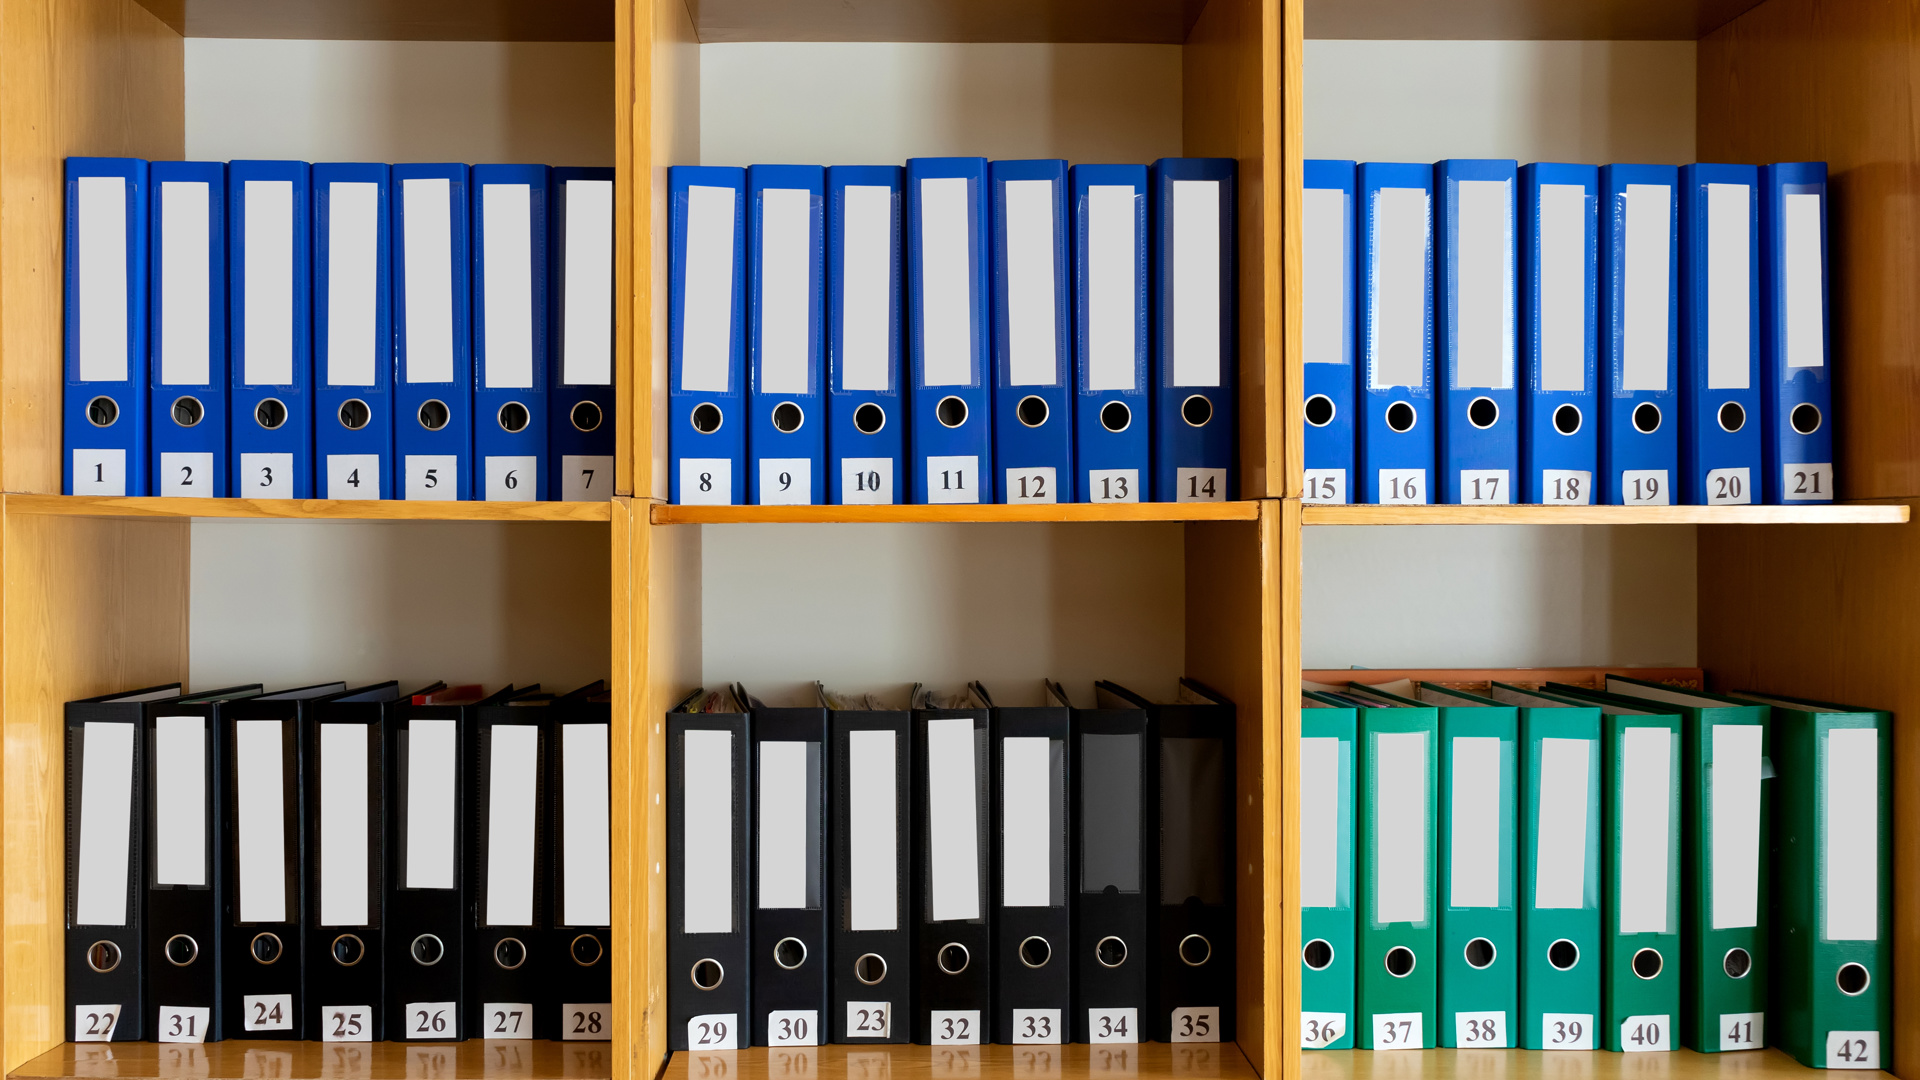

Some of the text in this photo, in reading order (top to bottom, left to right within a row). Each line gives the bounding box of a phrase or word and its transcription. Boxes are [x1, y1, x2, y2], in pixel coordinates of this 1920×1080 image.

[95, 463, 103, 483] 1
[180, 466, 193, 486] 2
[259, 466, 273, 487] 3
[346, 468, 360, 488] 4
[424, 469, 438, 489] 5
[504, 469, 518, 490] 6
[581, 469, 595, 489] 7
[699, 472, 712, 492] 8
[778, 471, 792, 492] 9
[856, 471, 880, 491] 10
[942, 470, 964, 489] 11
[1794, 472, 1821, 493] 21
[1018, 476, 1045, 497] 12
[1102, 477, 1128, 499] 13
[1189, 476, 1216, 497] 14
[1309, 478, 1335, 499] 15
[1391, 477, 1416, 499] 16
[1472, 478, 1499, 499] 17
[1555, 478, 1579, 500] 18
[1634, 478, 1658, 500] 19
[1716, 476, 1741, 498] 20
[87, 1013, 114, 1034] 22
[254, 1002, 282, 1024] 24
[417, 1010, 445, 1032] 26
[494, 1011, 523, 1032] 27
[573, 1012, 601, 1033] 28
[857, 1010, 885, 1030] 23
[169, 1015, 195, 1036] 31
[333, 1013, 361, 1037] 25
[698, 1022, 726, 1044] 29
[778, 1018, 807, 1039] 30
[941, 1018, 969, 1039] 32
[1023, 1017, 1051, 1038] 33
[1099, 1016, 1127, 1037] 34
[1180, 1015, 1209, 1036] 35
[1306, 1020, 1335, 1042] 36
[1383, 1021, 1412, 1043] 37
[1467, 1020, 1496, 1041] 38
[1553, 1022, 1582, 1043] 39
[1631, 1023, 1659, 1045] 40
[1729, 1021, 1753, 1043] 41
[1837, 1040, 1867, 1061] 42
